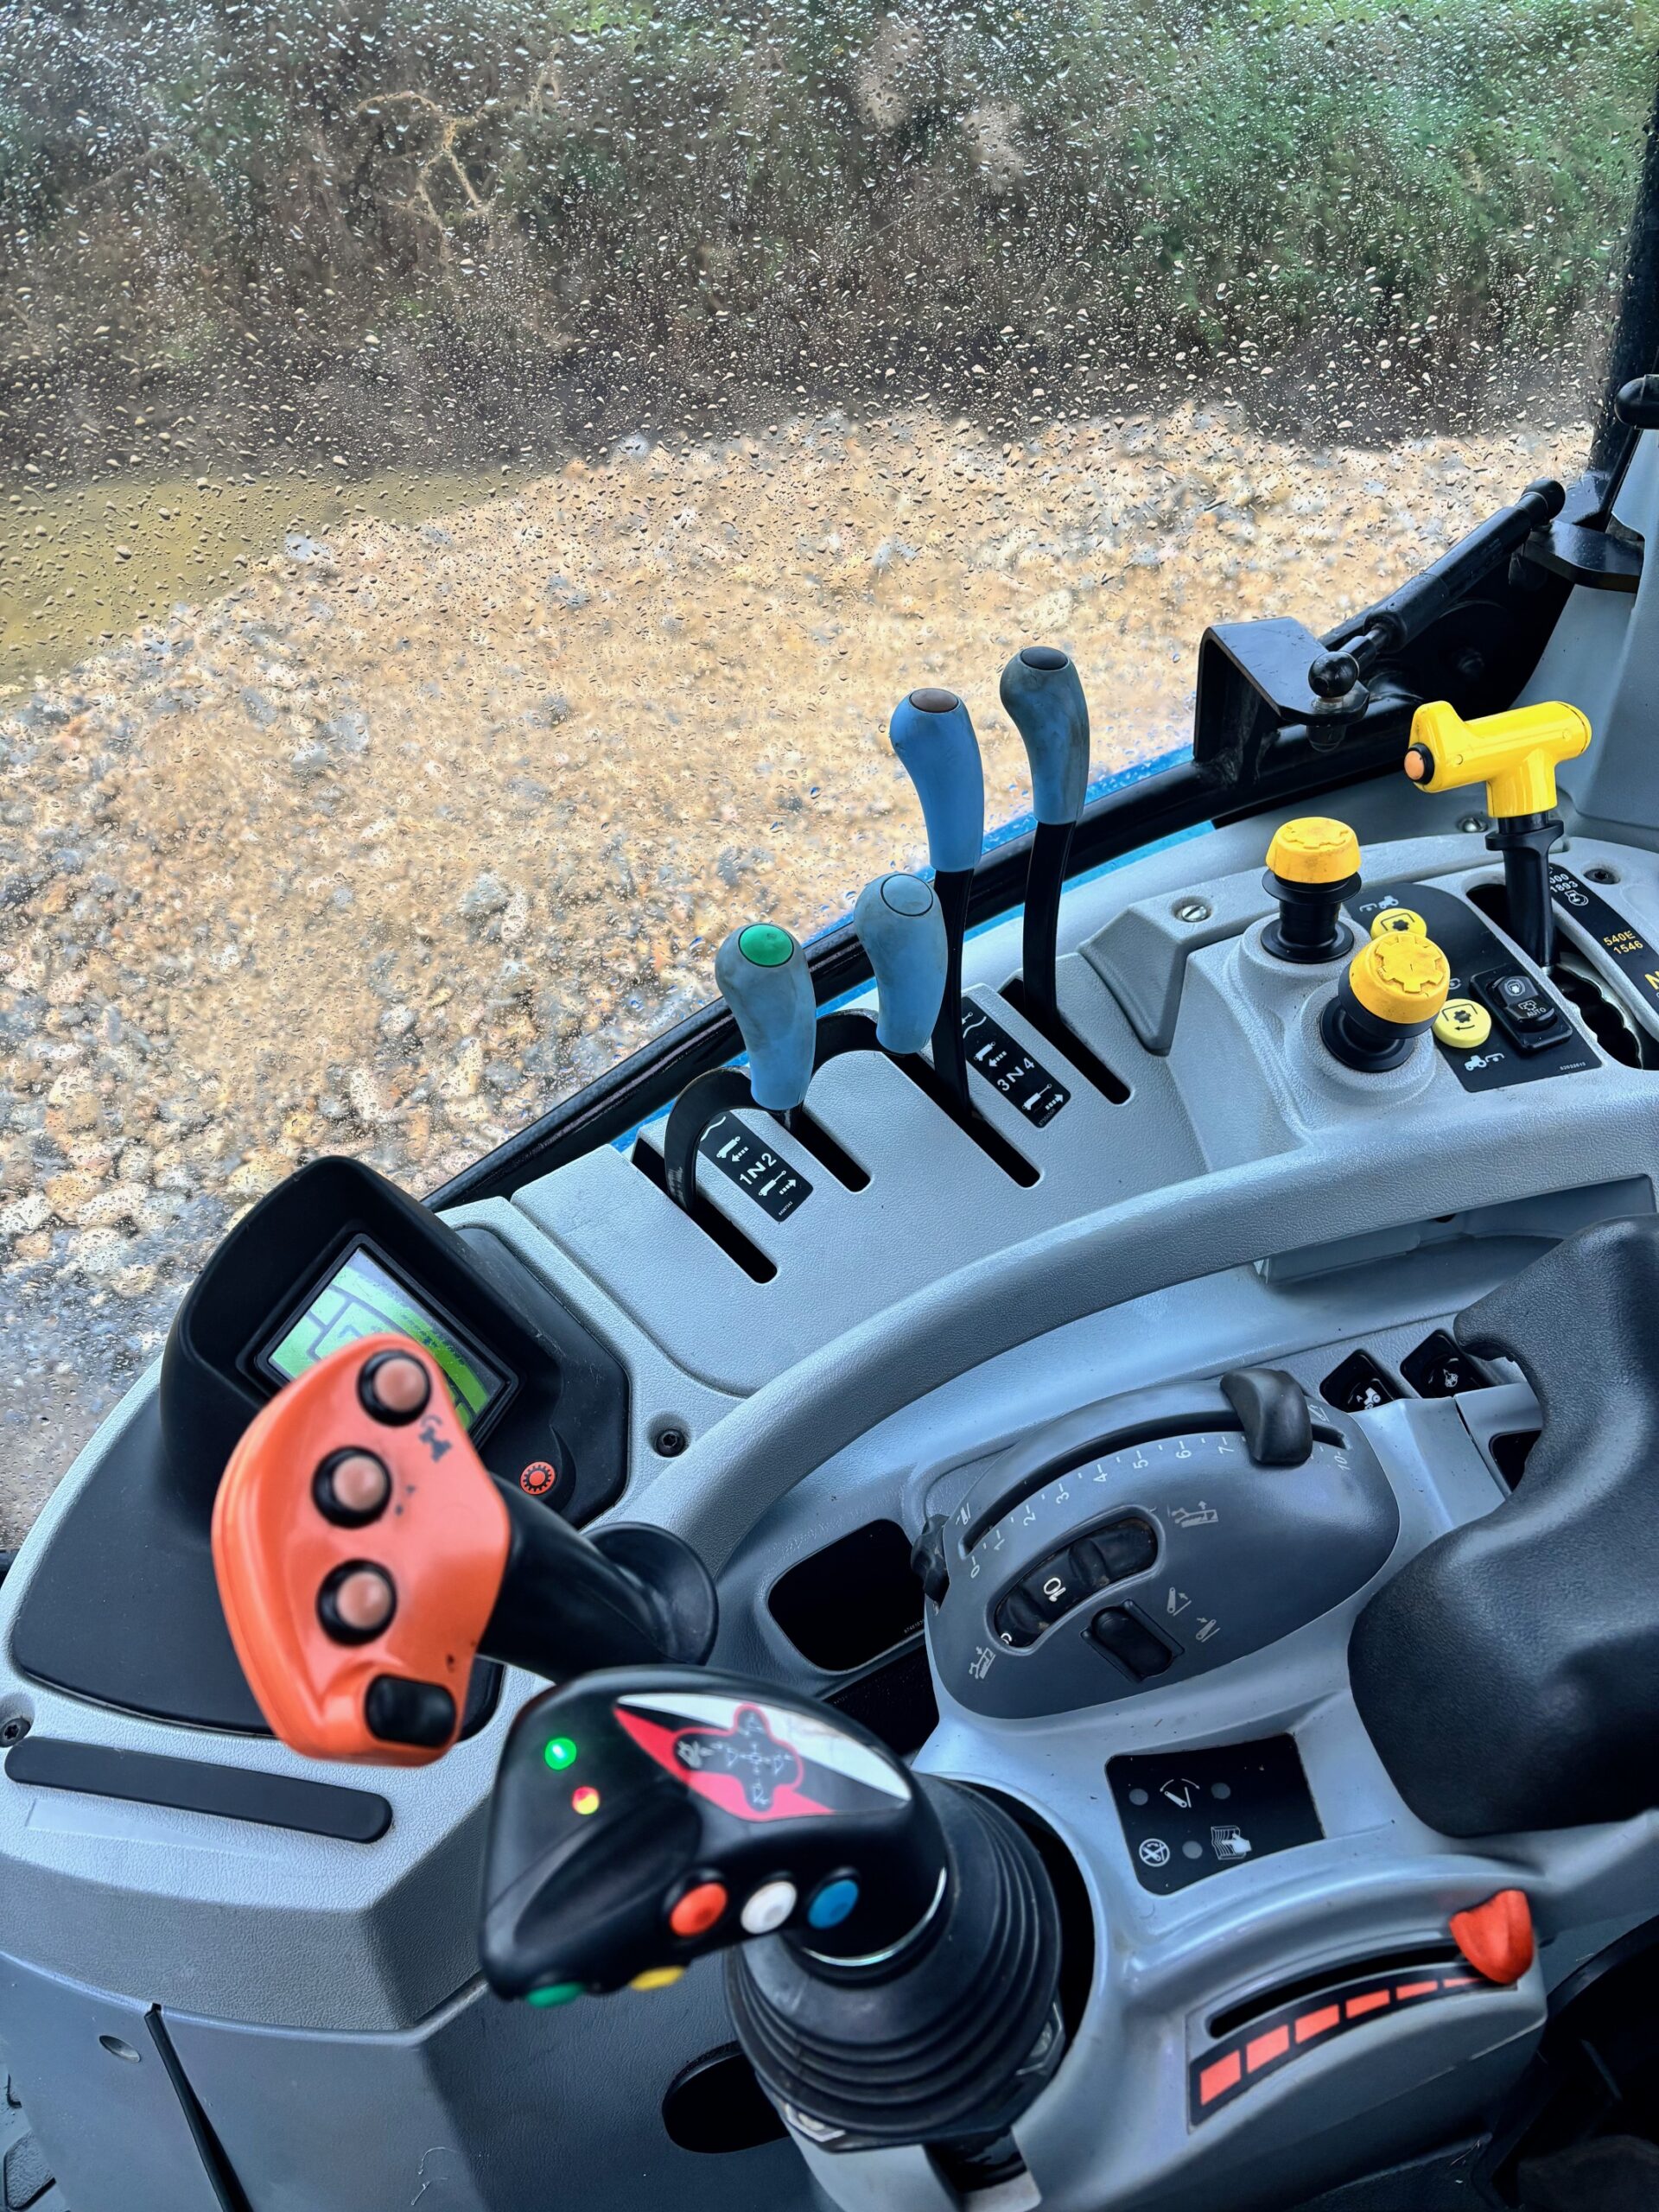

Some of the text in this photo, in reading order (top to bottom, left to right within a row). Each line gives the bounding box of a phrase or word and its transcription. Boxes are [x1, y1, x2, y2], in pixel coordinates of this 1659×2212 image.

[1550, 880, 1579, 893] 1893
[1603, 930, 1636, 946] 540E
[1613, 940, 1643, 955] 1546
[1527, 1007, 1547, 1017] AUTO
[996, 1057, 1035, 1091] 3 N 4
[1355, 1394, 1363, 1403] A
[1023, 1511, 1037, 1527] 2
[1055, 1491, 1070, 1504] 3
[1092, 1472, 1109, 1484] 4
[1132, 1459, 1149, 1470] 5
[1175, 1449, 1192, 1459] 6
[1043, 1577, 1066, 1602] 10
